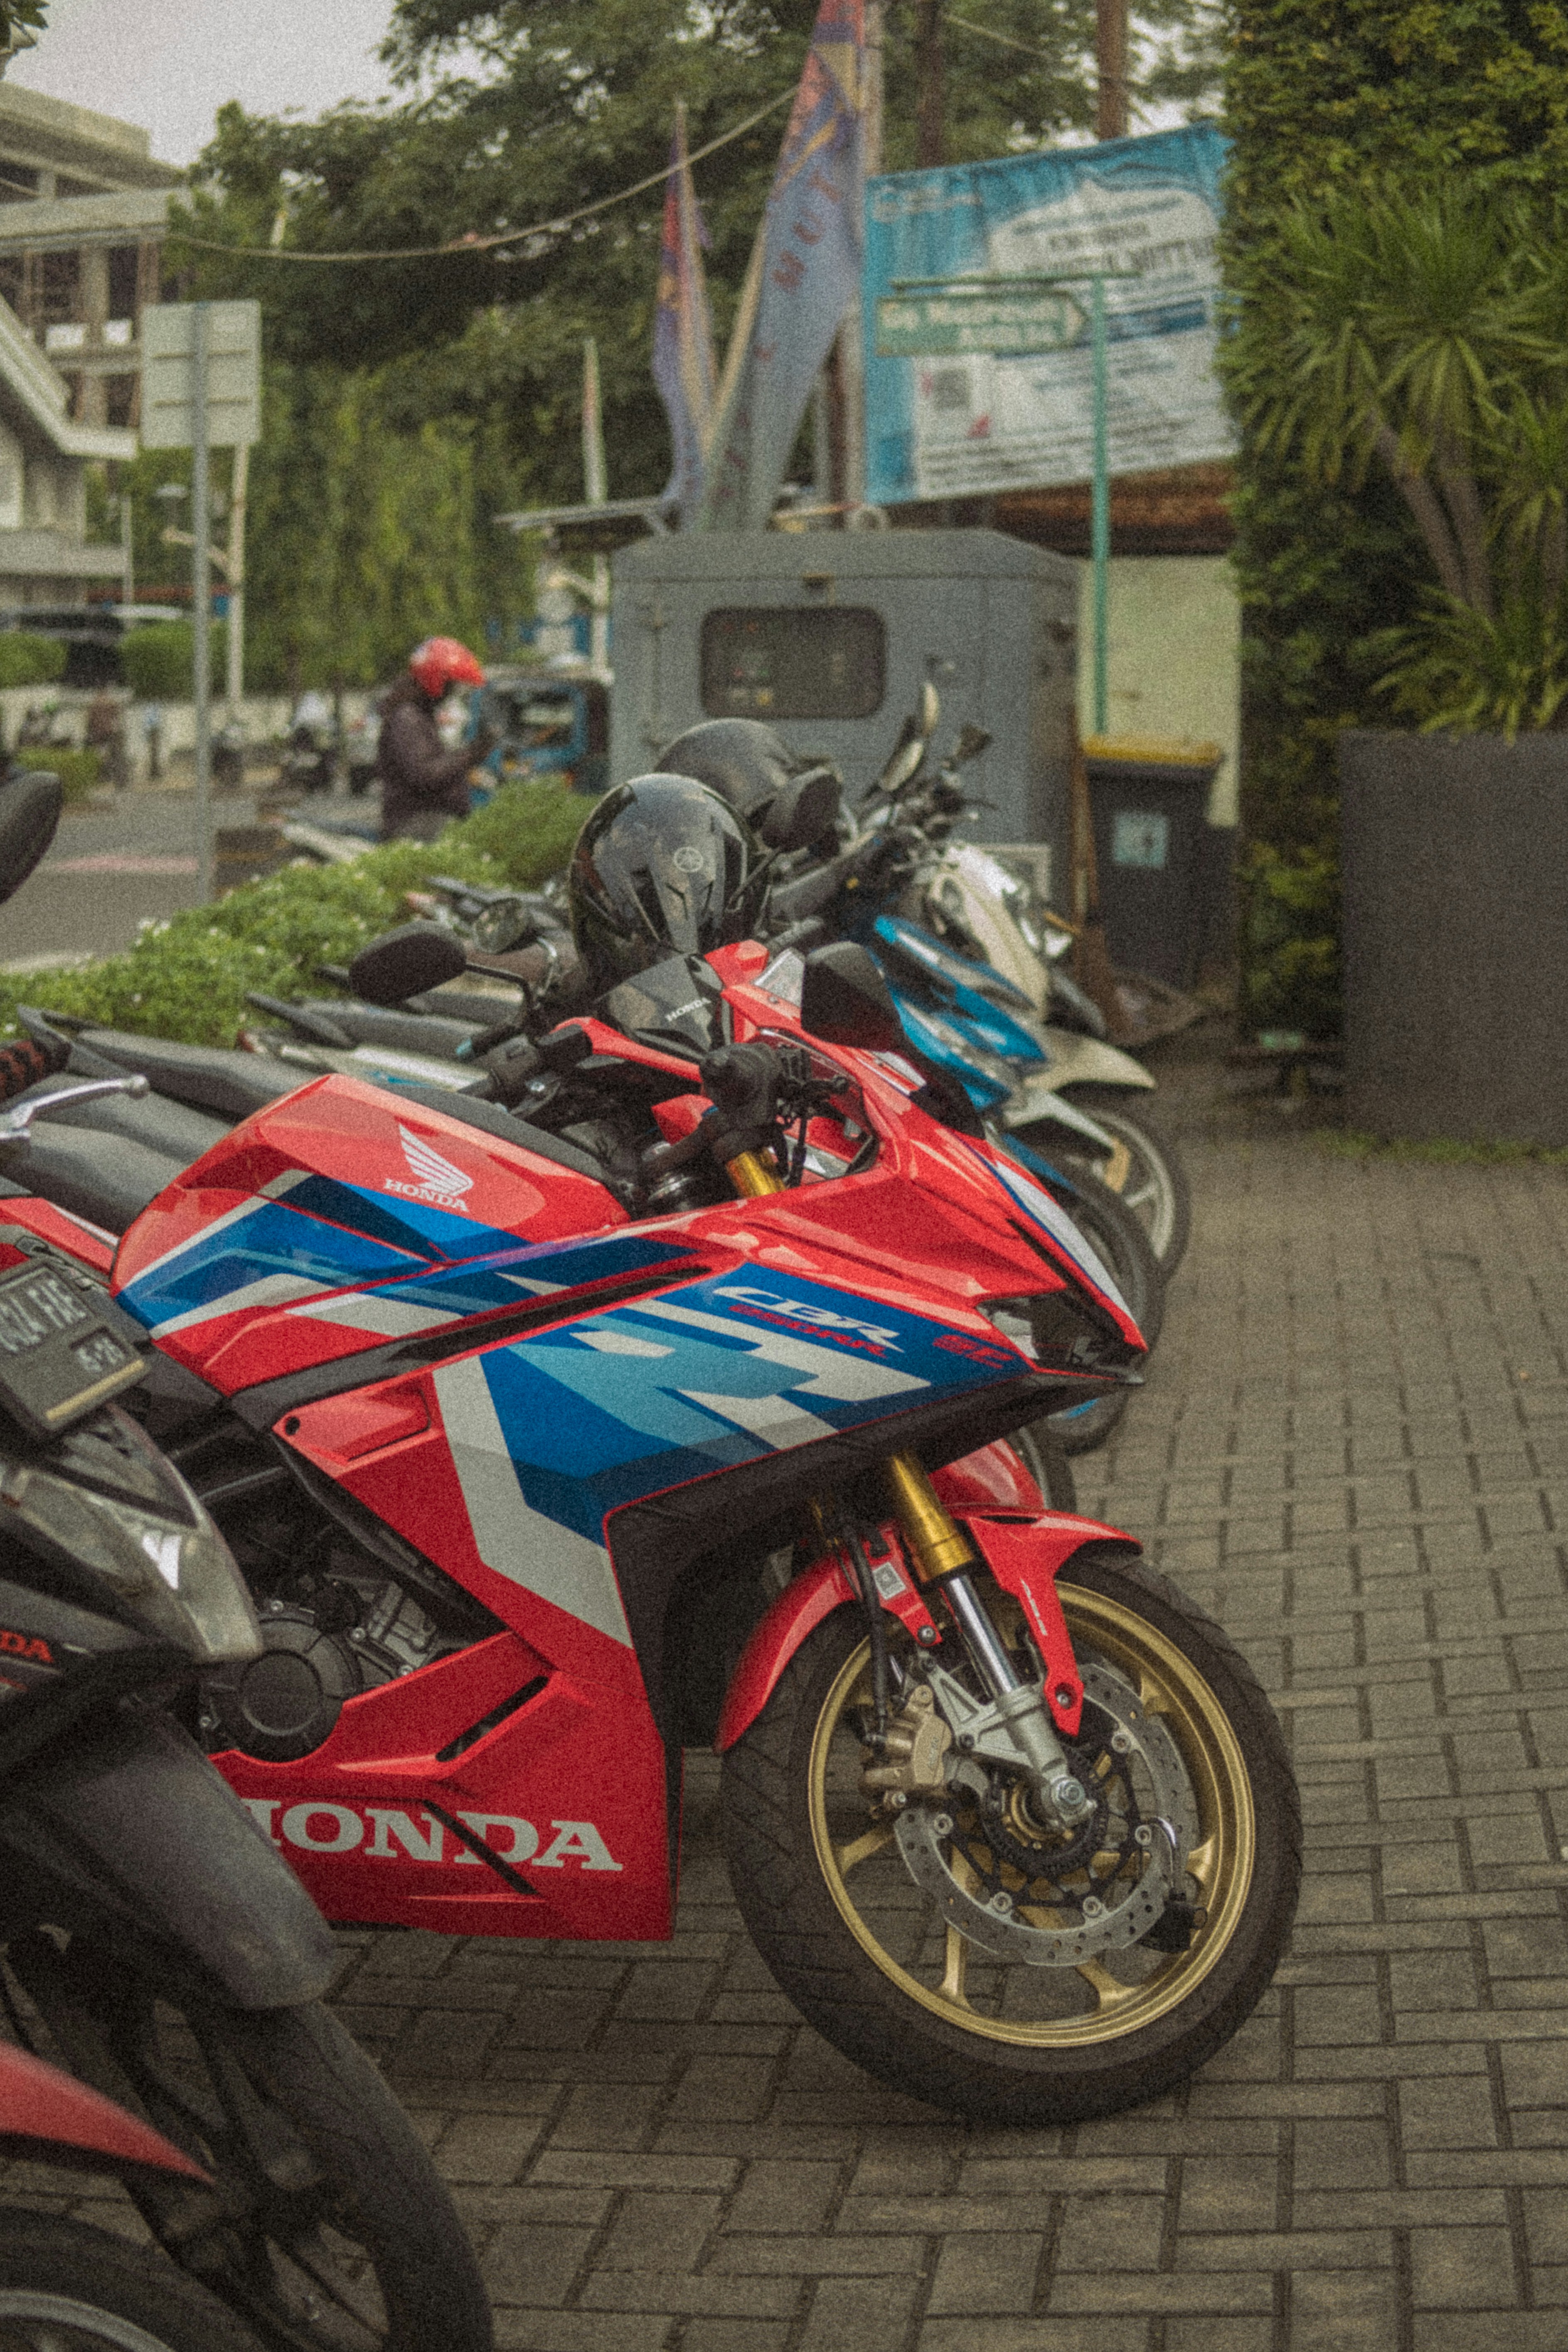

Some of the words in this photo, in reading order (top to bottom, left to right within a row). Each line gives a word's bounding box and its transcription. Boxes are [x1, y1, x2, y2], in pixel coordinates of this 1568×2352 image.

[665, 996, 712, 1022] HONDA
[383, 1178, 469, 1212] HONDA
[713, 1287, 905, 1353] CBR
[729, 1304, 887, 1358] 250RR
[933, 1334, 1014, 1369] SP
